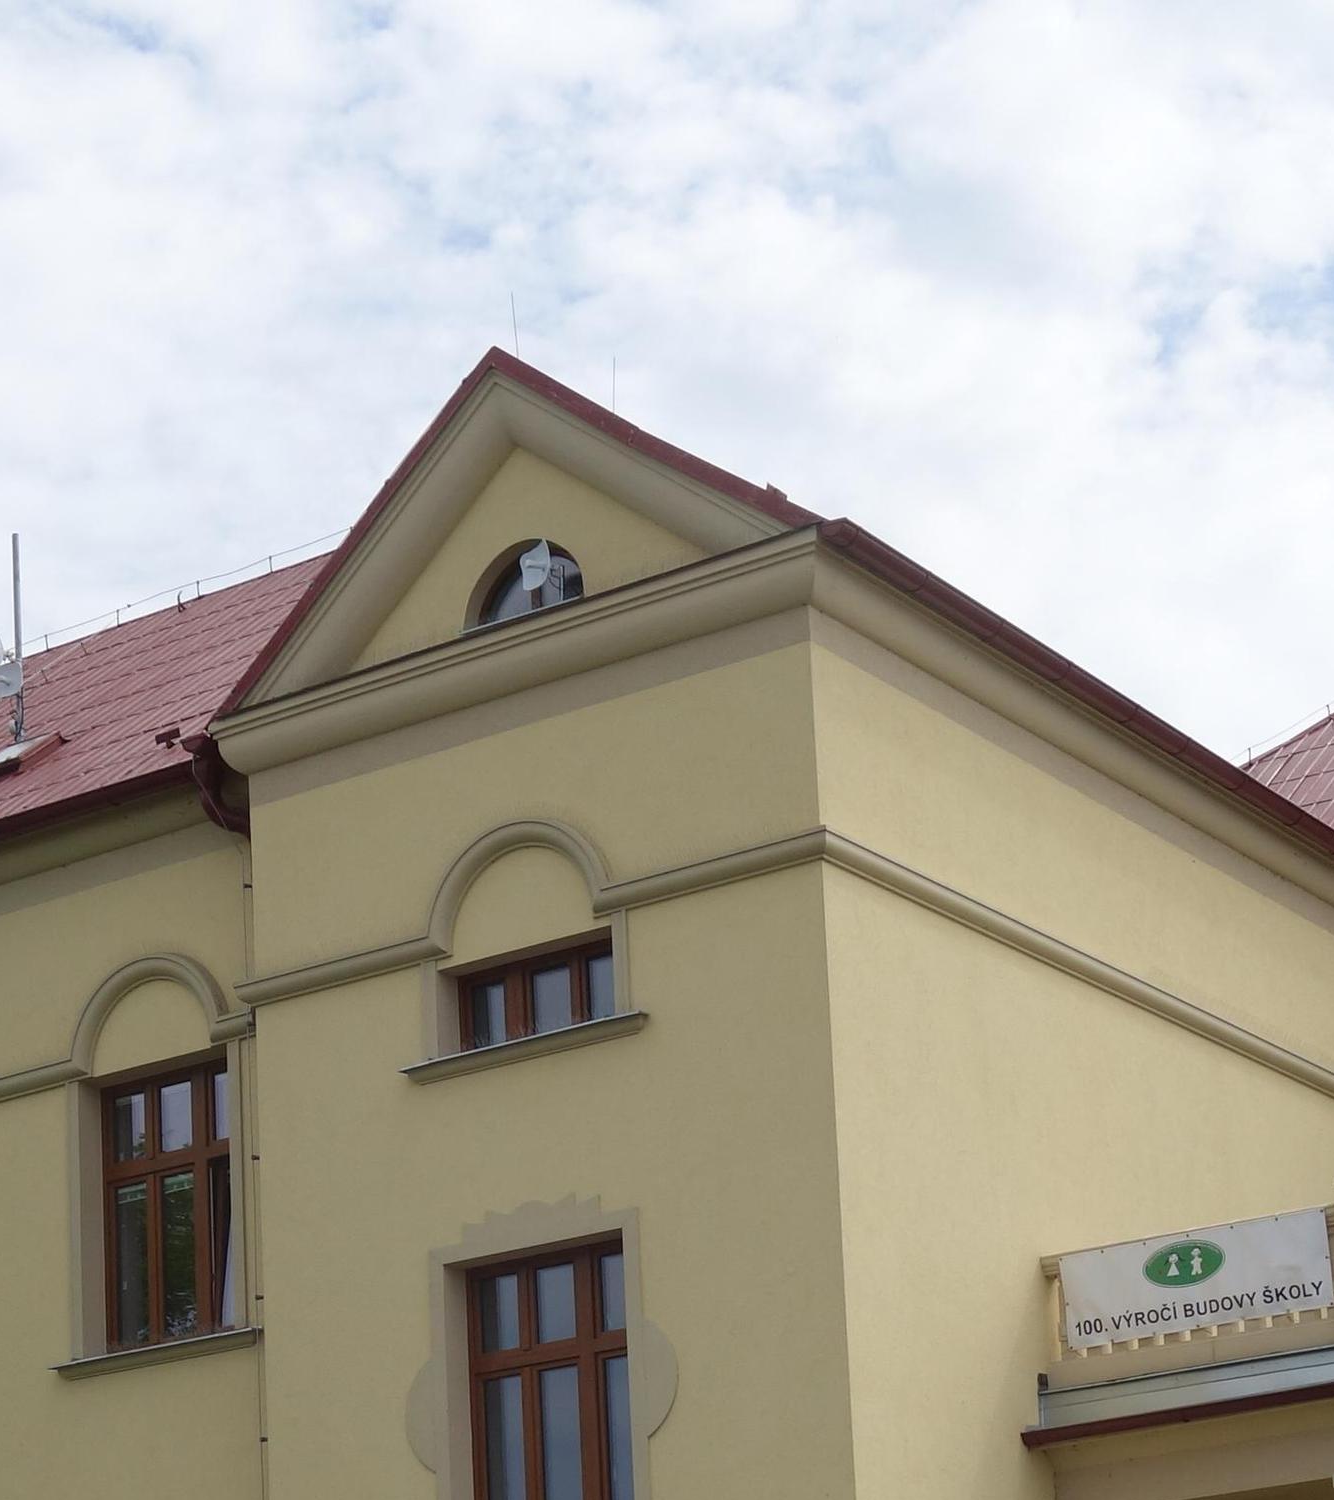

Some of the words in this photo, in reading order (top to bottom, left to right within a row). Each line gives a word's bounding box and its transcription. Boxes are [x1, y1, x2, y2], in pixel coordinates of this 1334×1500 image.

[1075, 1317, 1108, 1337] 100.
[1111, 1303, 1177, 1330] VÝROČÍ
[1184, 1291, 1257, 1318] BUDOVY
[1262, 1281, 1323, 1304] ŠKOLY
